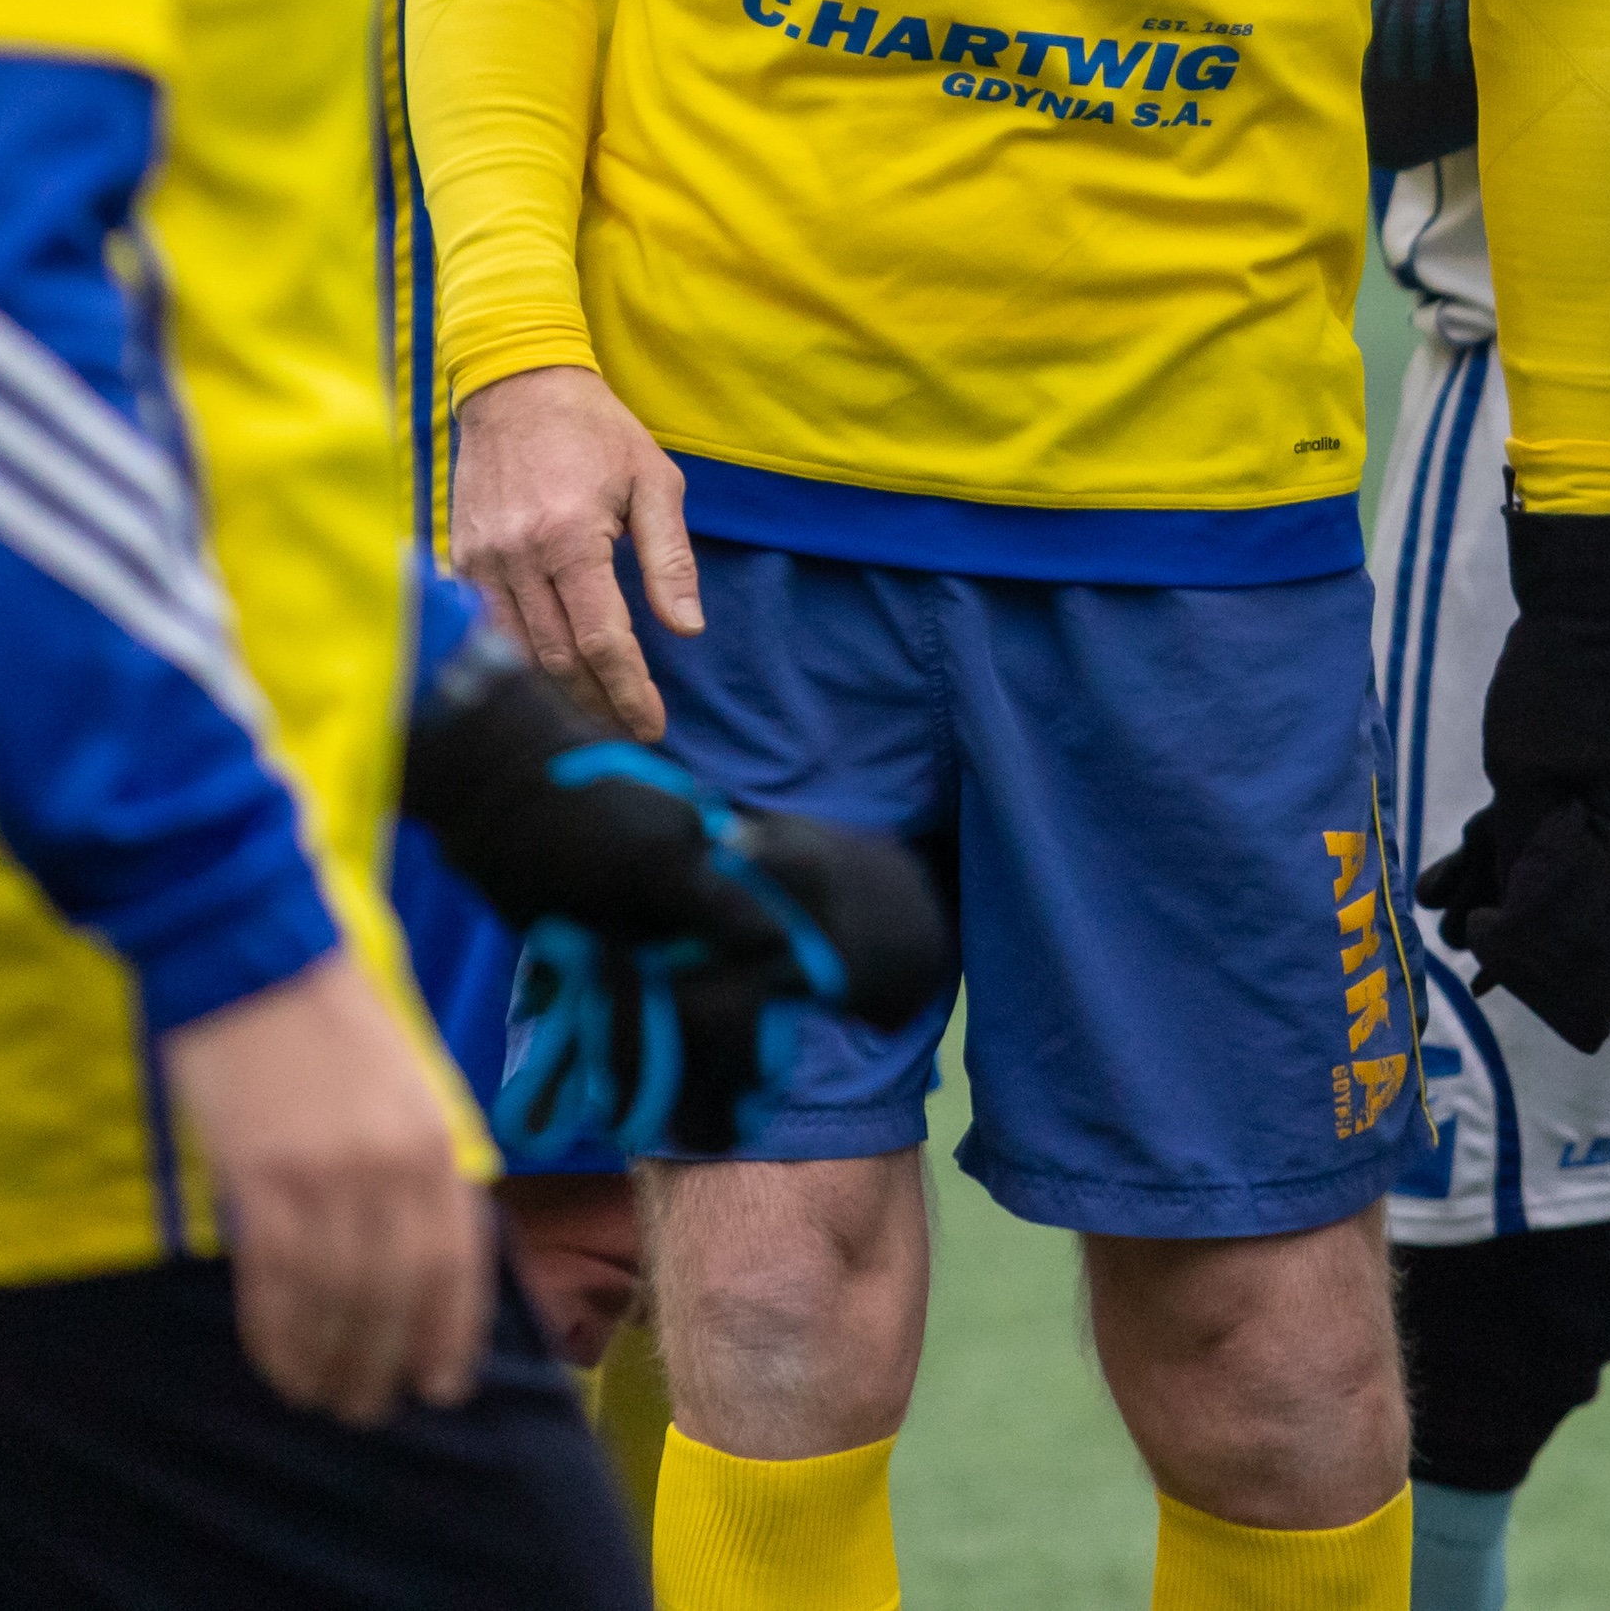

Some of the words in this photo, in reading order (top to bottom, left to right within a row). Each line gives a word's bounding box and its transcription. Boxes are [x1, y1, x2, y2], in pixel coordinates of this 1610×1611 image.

[942, 72, 1115, 125] GDYNIA
[1131, 101, 1212, 128] S.A.
[1323, 831, 1408, 1136] ARKA
